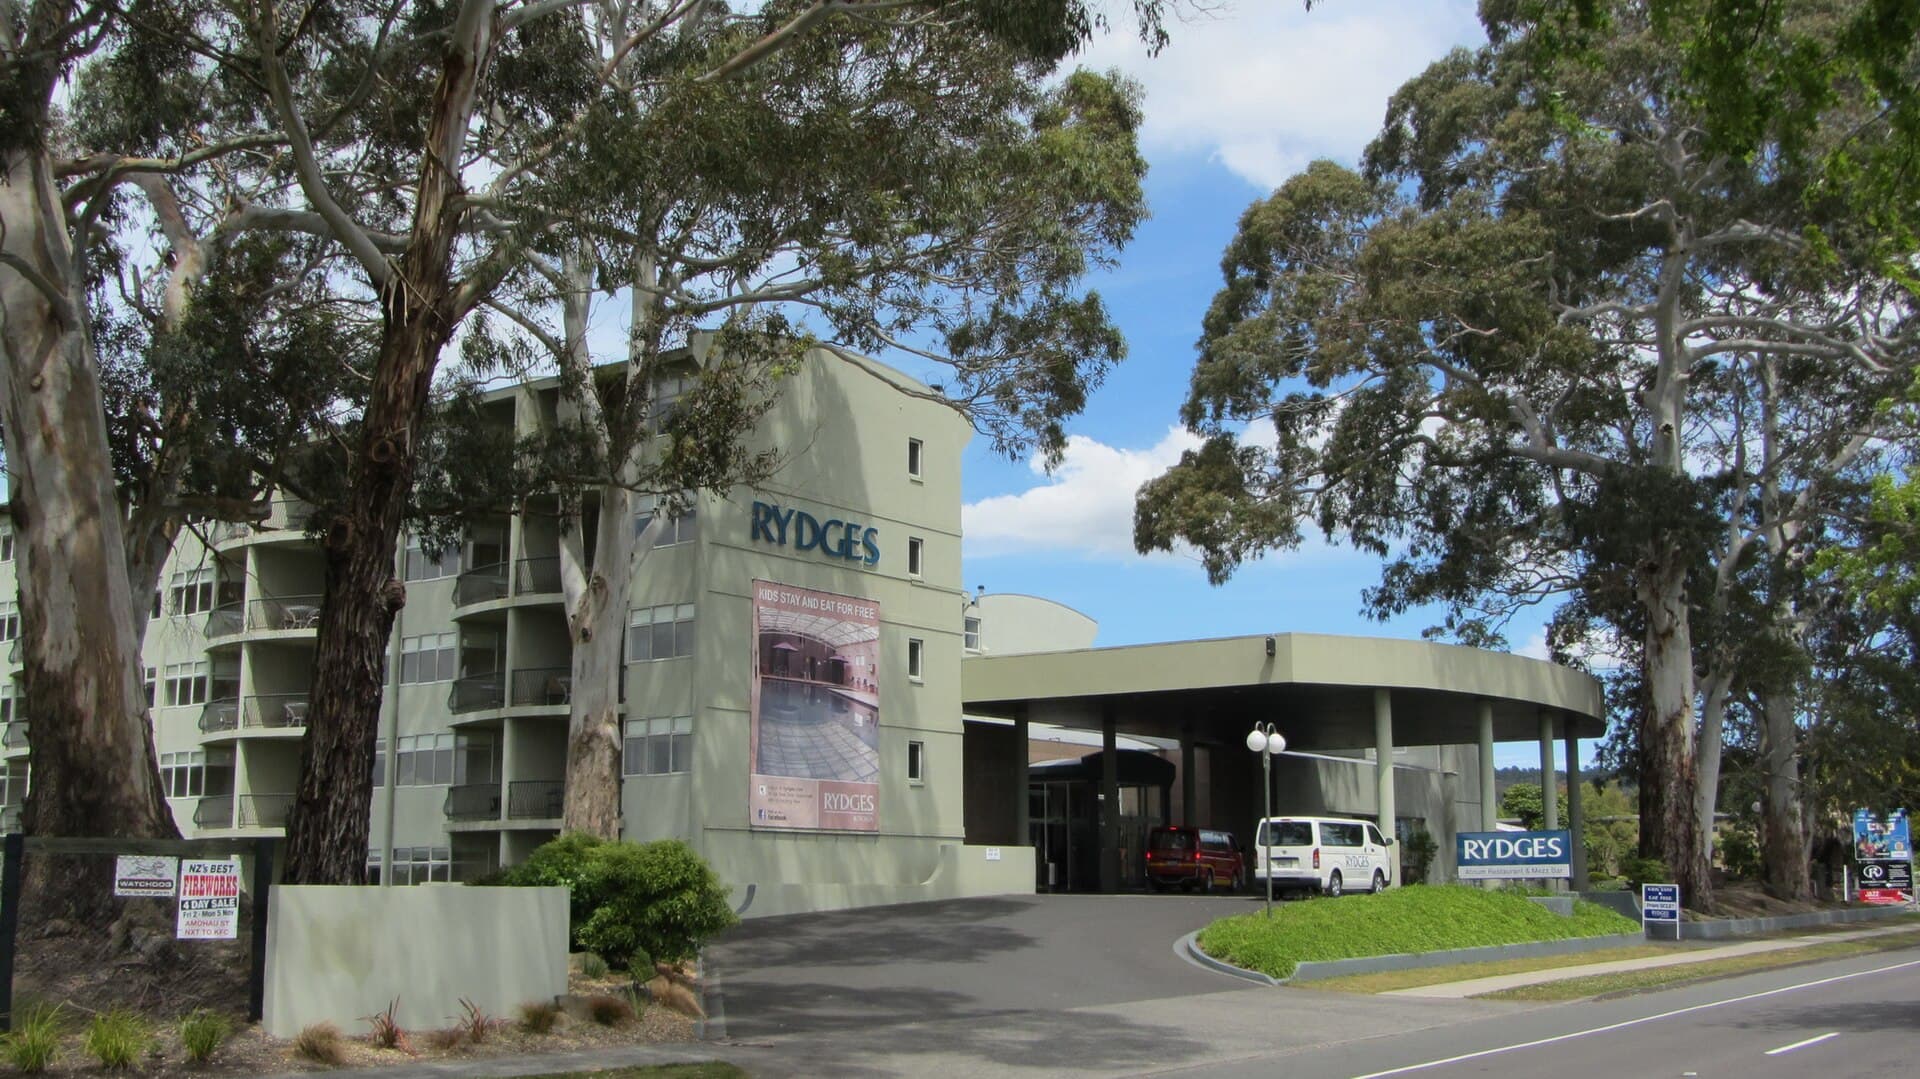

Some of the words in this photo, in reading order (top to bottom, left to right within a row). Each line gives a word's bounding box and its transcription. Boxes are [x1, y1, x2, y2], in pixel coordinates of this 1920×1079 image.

[752, 501, 881, 566] RYDGES
[758, 588, 779, 602] KIDS
[780, 592, 801, 605] STAY
[802, 596, 819, 609] AND
[820, 600, 836, 612] EAT
[837, 602, 854, 615] FOR
[854, 605, 875, 619] FREE
[823, 792, 874, 812] RYDGES
[1463, 837, 1562, 860] RYDGES
[189, 864, 208, 873] NZ's
[210, 864, 234, 873] BEST
[1345, 856, 1369, 867] RYDGES
[183, 874, 237, 896] FIREWORKS
[183, 900, 190, 909] 4
[191, 899, 210, 909] DAY
[211, 898, 236, 908] SALE
